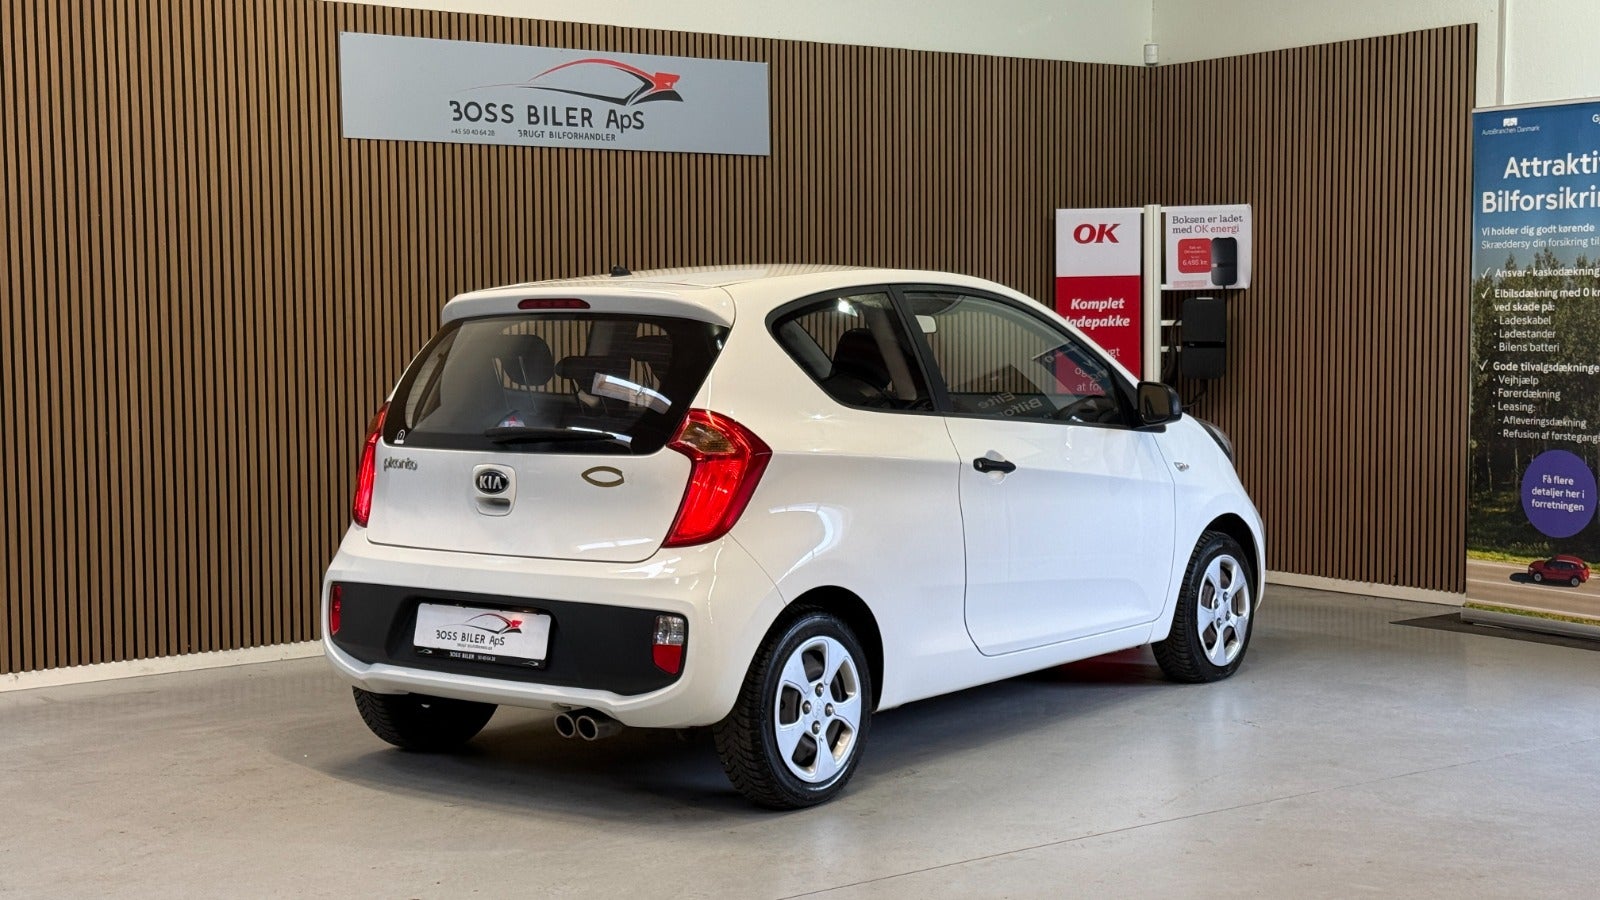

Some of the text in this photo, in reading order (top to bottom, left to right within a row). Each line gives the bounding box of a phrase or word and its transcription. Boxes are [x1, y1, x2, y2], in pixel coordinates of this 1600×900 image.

[527, 104, 593, 128] BILER
[605, 109, 645, 133] ApS
[1517, 125, 1540, 133] Danmark
[549, 131, 616, 142] BILFORHANDLER
[1503, 150, 1600, 179] Attrakti
[1172, 215, 1205, 224] Boksen
[1219, 214, 1243, 223] ladet
[1073, 223, 1121, 244] OK
[1172, 224, 1239, 234] med OK energi
[1481, 227, 1490, 236] Vi
[1491, 225, 1518, 236] holder
[1520, 225, 1535, 237] dig
[1536, 224, 1557, 237] godt
[1481, 239, 1530, 250] Skræddersy
[1532, 239, 1546, 248] din
[1548, 237, 1588, 248] forsikring
[1494, 266, 1600, 278] Ansvar- kaskodækning
[1494, 288, 1558, 299] Elbilsdækning
[1560, 288, 1581, 297] med
[1583, 287, 1590, 297] 0
[1070, 297, 1125, 312] Komplet
[1494, 301, 1555, 313] ved skade på:
[1499, 316, 1551, 325] Ladeskabel
[1499, 329, 1556, 338] Ladestander
[1499, 342, 1560, 352] Bilens batteri
[1493, 361, 1518, 371] Gode
[1498, 375, 1539, 387] Vejhjælp
[1498, 388, 1561, 401] Førerdækning
[1503, 416, 1587, 429] Afleveringsdækning
[1503, 429, 1540, 439] Refusion
[1541, 431, 1550, 439] af
[479, 475, 503, 490] KIA
[1542, 474, 1574, 485] Få flere
[1531, 487, 1563, 498] detaljer
[1565, 490, 1580, 499] her
[1531, 499, 1585, 513] forretningen
[461, 632, 486, 644] BILER
[489, 635, 505, 647] ApS
